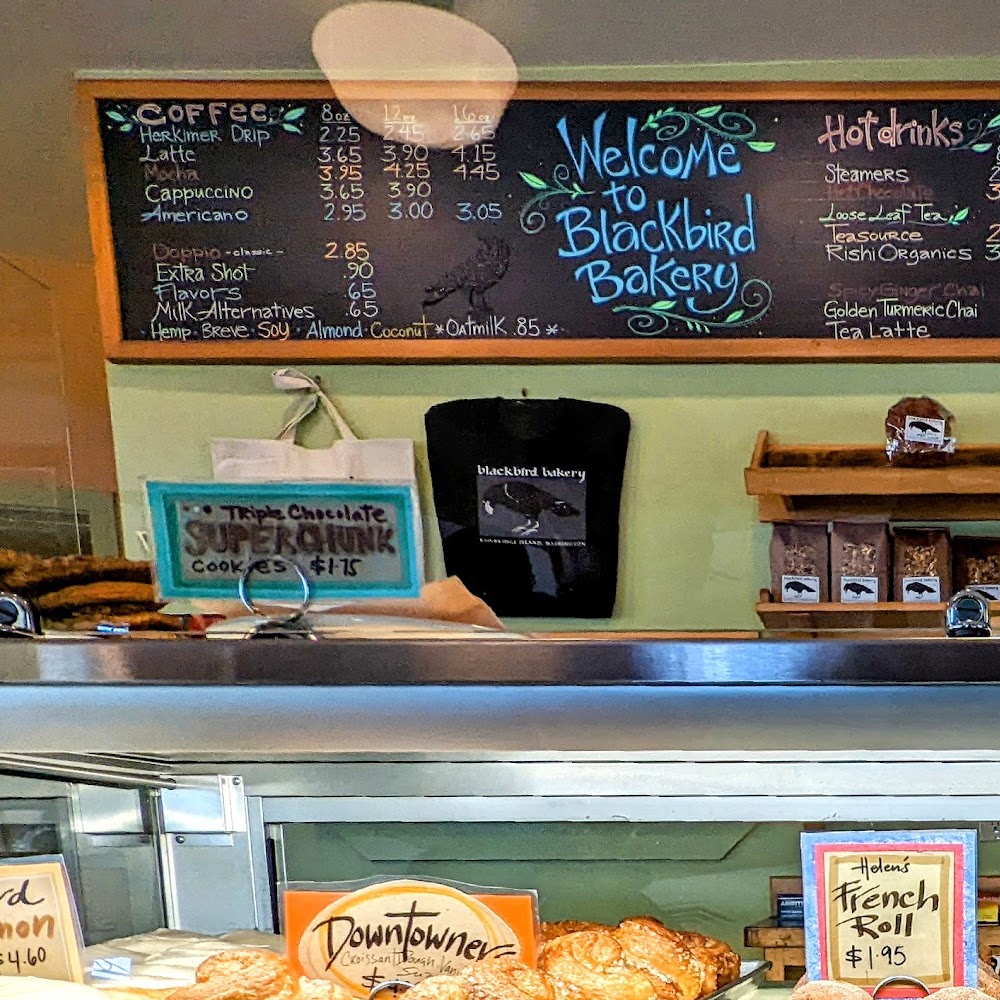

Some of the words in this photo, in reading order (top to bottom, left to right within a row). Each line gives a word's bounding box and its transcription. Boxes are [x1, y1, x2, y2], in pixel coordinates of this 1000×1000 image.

[139, 146, 196, 163] Latte
[317, 146, 362, 163] 3.65
[381, 144, 428, 162] 3.90
[451, 144, 496, 162] 4.15
[319, 165, 362, 181] 3.95
[384, 163, 430, 179] 4.25
[320, 183, 364, 200] 3.65
[602, 181, 647, 215] to
[324, 203, 367, 221] 2.95
[388, 201, 433, 219] 3.00
[456, 202, 502, 221] 3.05
[324, 242, 369, 260] 2.85
[477, 465, 539, 477] blackbird
[542, 467, 586, 483] bakery
[832, 879, 940, 914] French
[836, 913, 914, 940] Roll
[845, 945, 907, 970] $1.95
